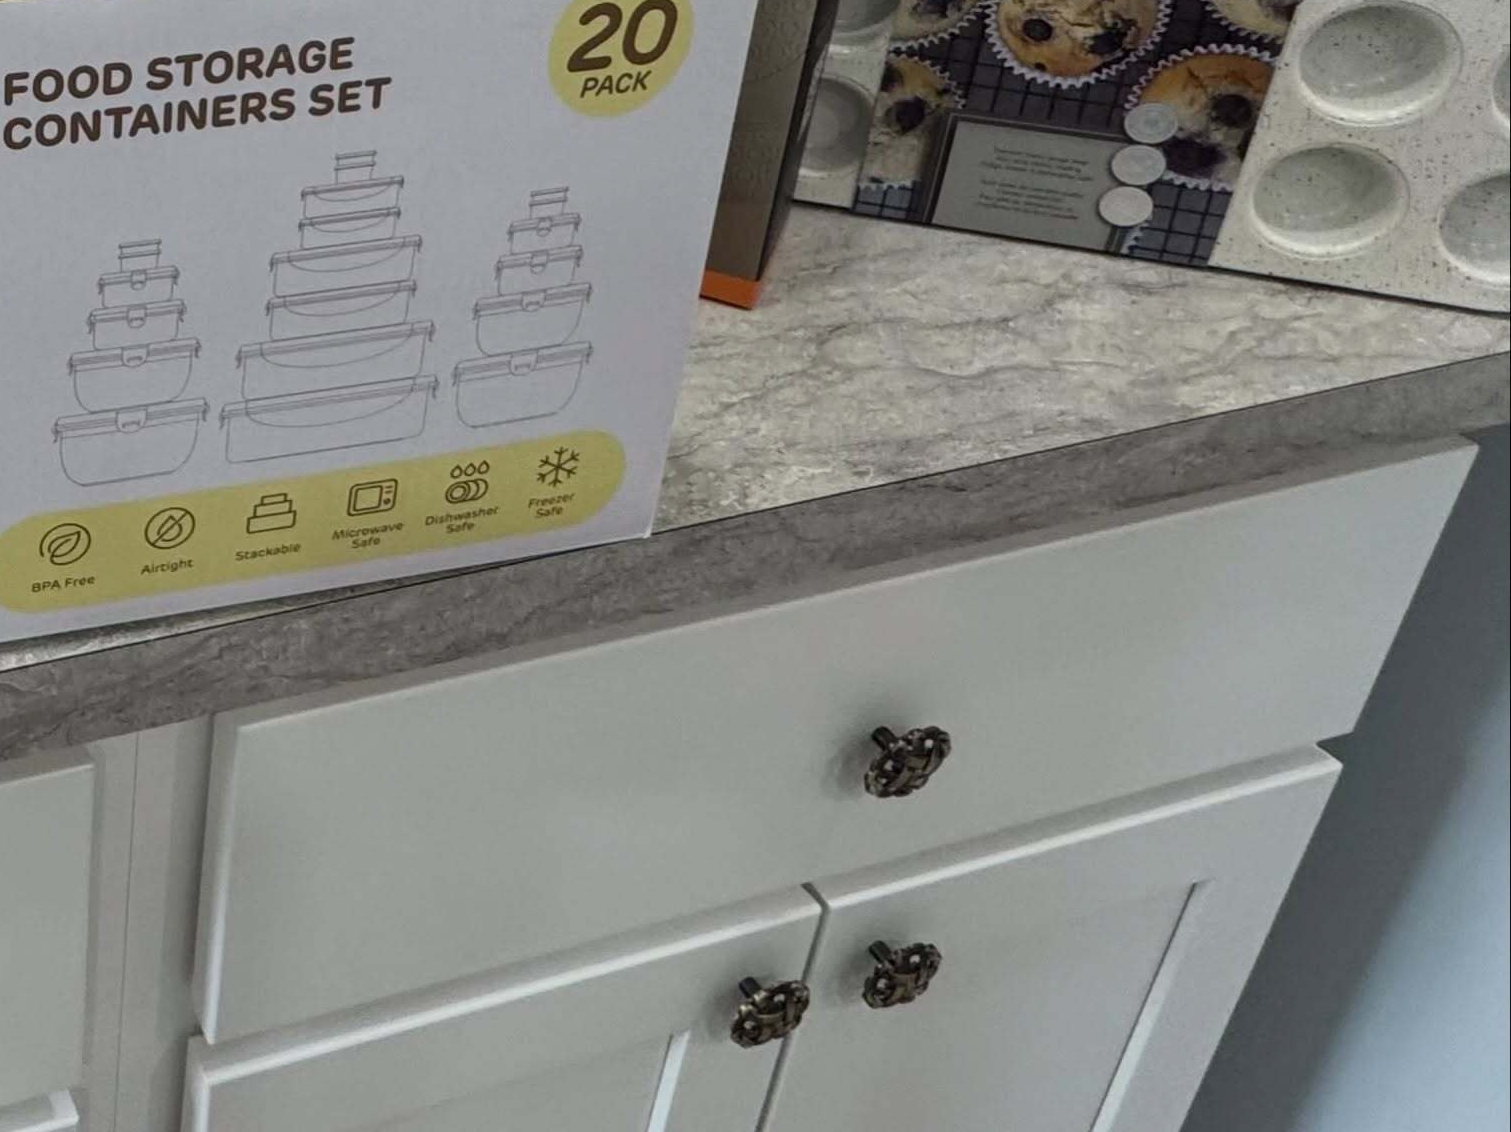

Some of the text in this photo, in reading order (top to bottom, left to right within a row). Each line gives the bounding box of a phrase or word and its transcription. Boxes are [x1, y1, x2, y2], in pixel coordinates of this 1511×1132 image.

[3, 36, 355, 107] FOOD STORAGE
[580, 69, 653, 99] PACK
[2, 76, 392, 151] CONTAINERS SET
[528, 492, 576, 509] Freezer
[425, 506, 499, 526] Dishwasher
[535, 505, 564, 518] Safe
[331, 521, 404, 541] Microwave
[445, 520, 475, 534] Safe
[235, 542, 302, 561] Stackable
[351, 536, 381, 549] Safe
[140, 558, 194, 575] Airtight
[31, 575, 95, 593] BPA Free
